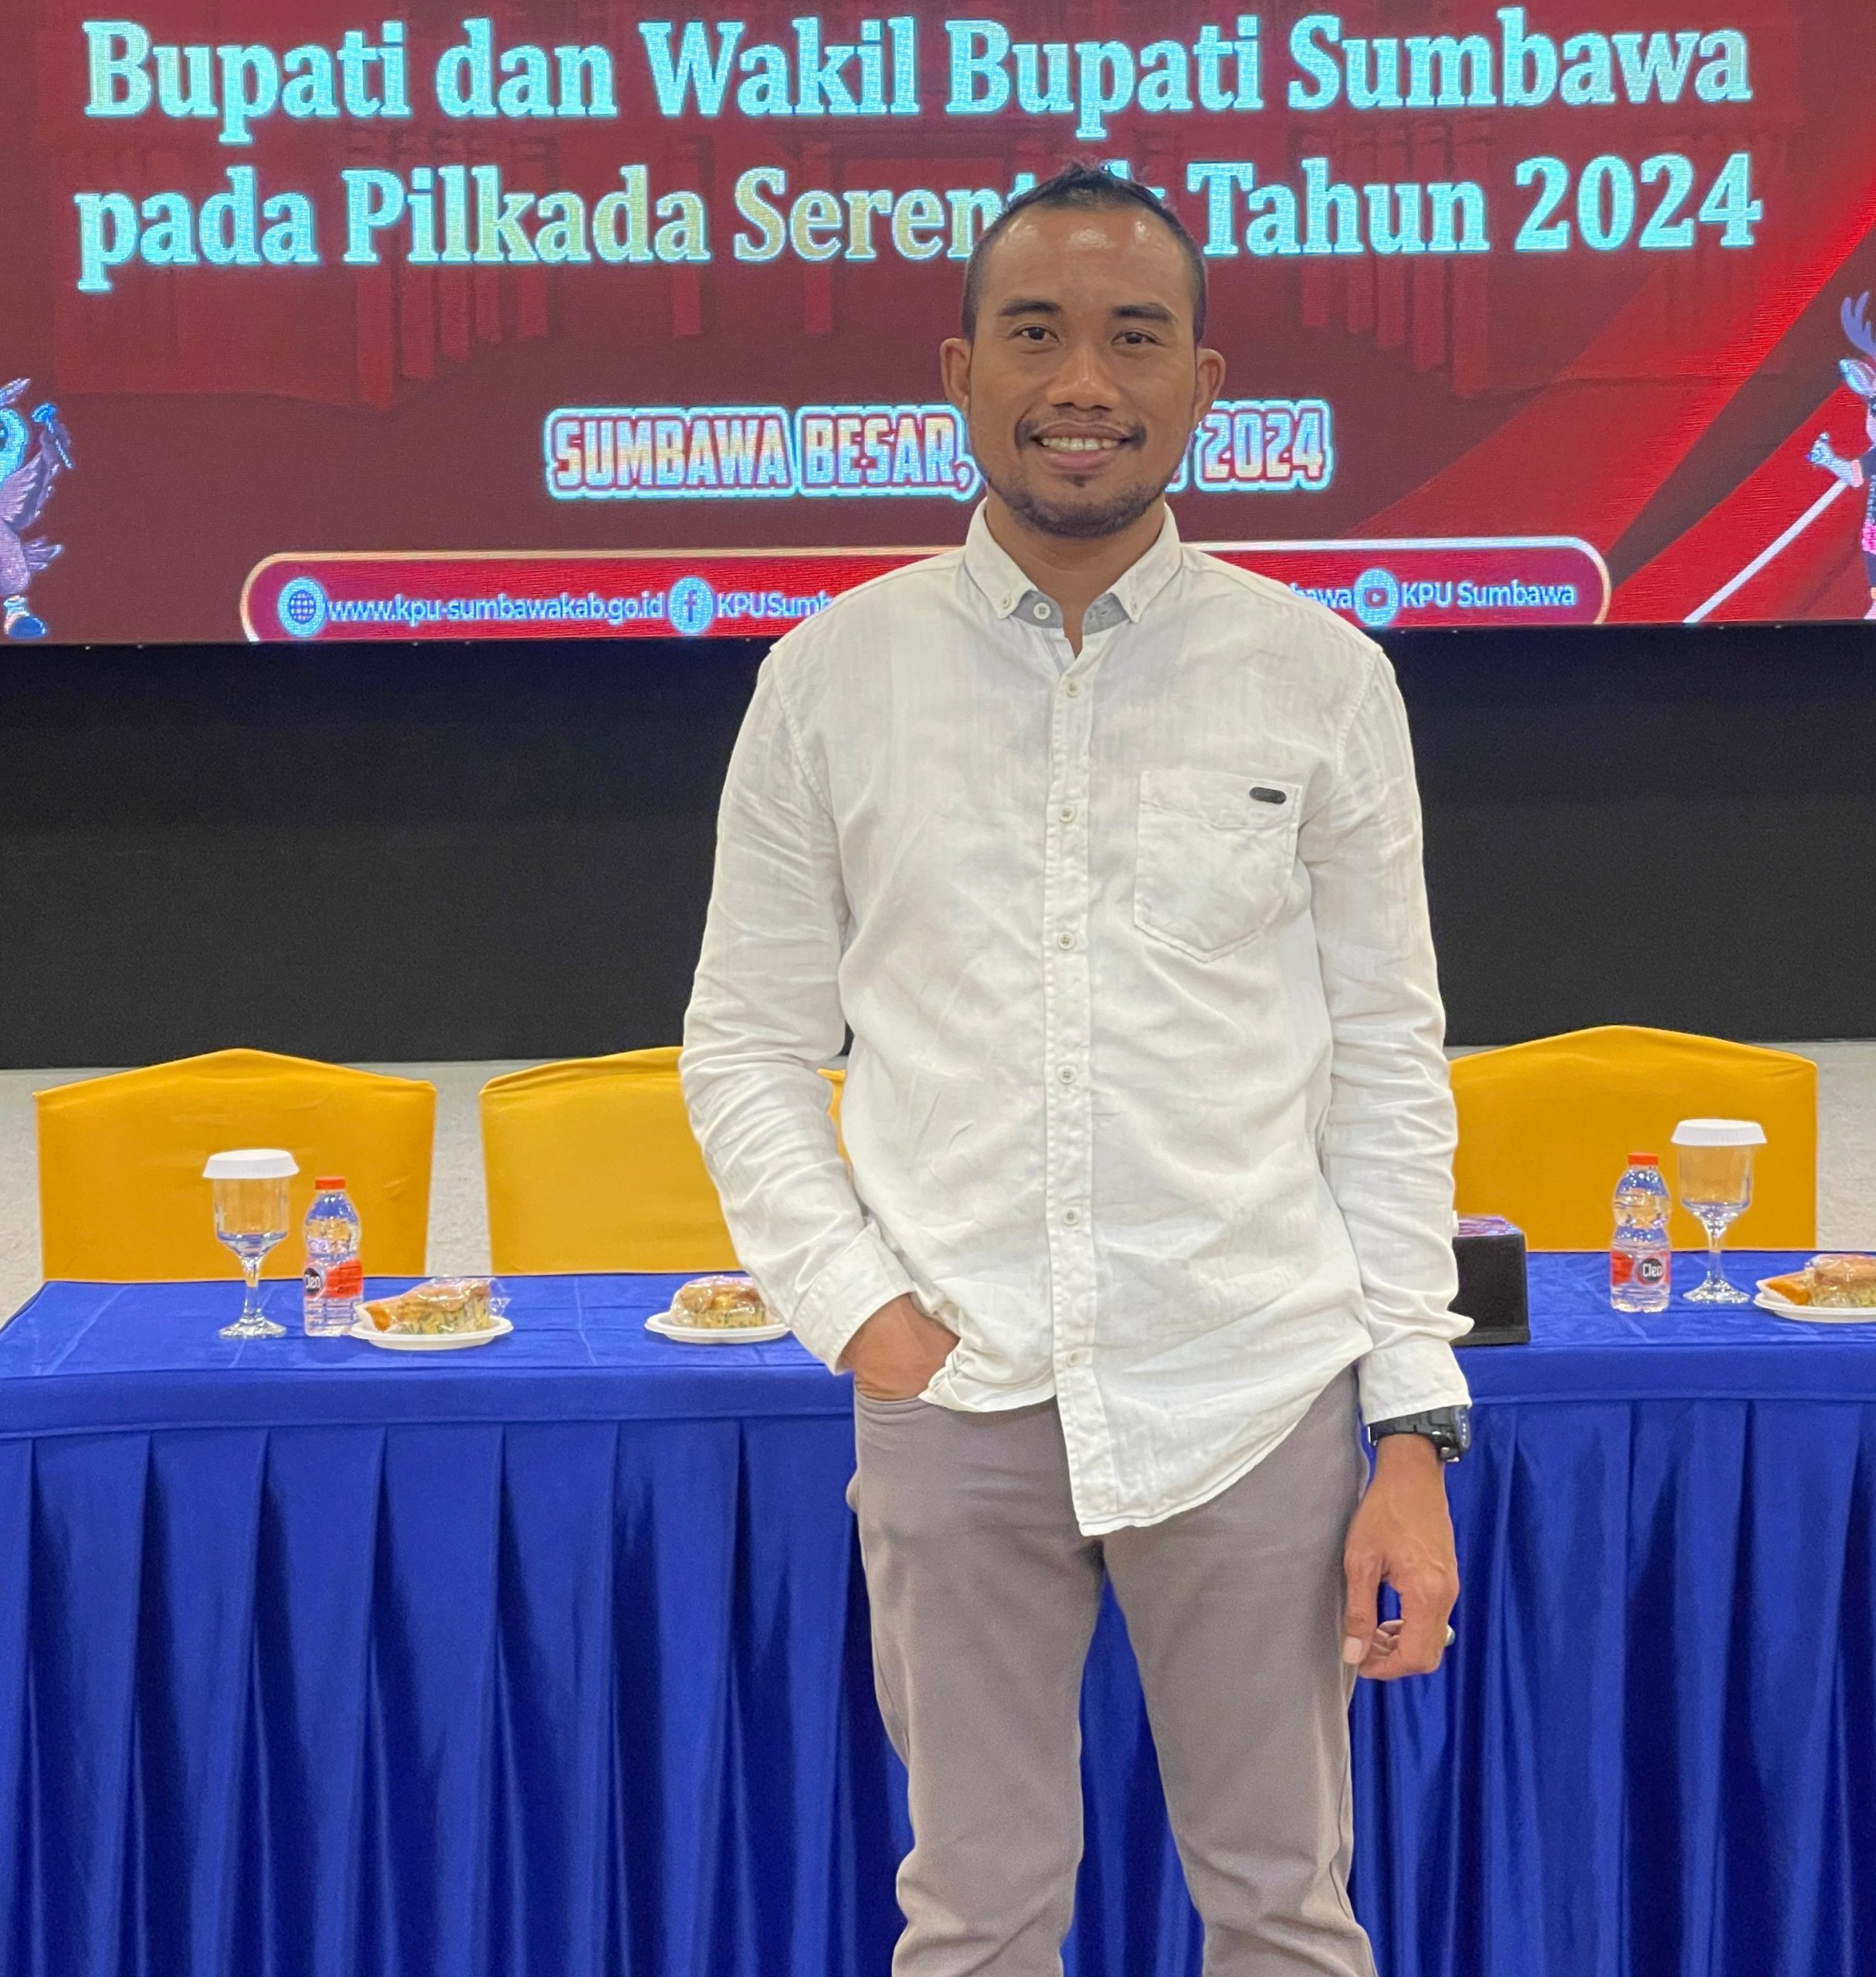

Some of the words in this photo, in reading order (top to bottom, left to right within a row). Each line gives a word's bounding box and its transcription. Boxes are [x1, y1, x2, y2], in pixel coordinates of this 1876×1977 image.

[83, 20, 412, 144] Bupati
[436, 18, 618, 117] dan
[638, 15, 920, 117] Wakil
[945, 15, 1264, 140] Bupati
[1287, 7, 1753, 110] Sumbawa
[73, 165, 318, 293] pada
[341, 164, 711, 265] Pilkada
[734, 159, 1166, 261] Seren
[1186, 157, 1491, 256] Tahun
[1513, 153, 1763, 253] 2024
[555, 420, 789, 488] SUMBAWA
[803, 418, 975, 490] BESAR,
[1203, 412, 1324, 479] 2024
[327, 591, 665, 627] www.kpu-sumbawakab.go.id
[1401, 582, 1452, 607] KPU
[1457, 578, 1576, 607] Sumbawa
[1642, 1263, 1663, 1277] Cleo
